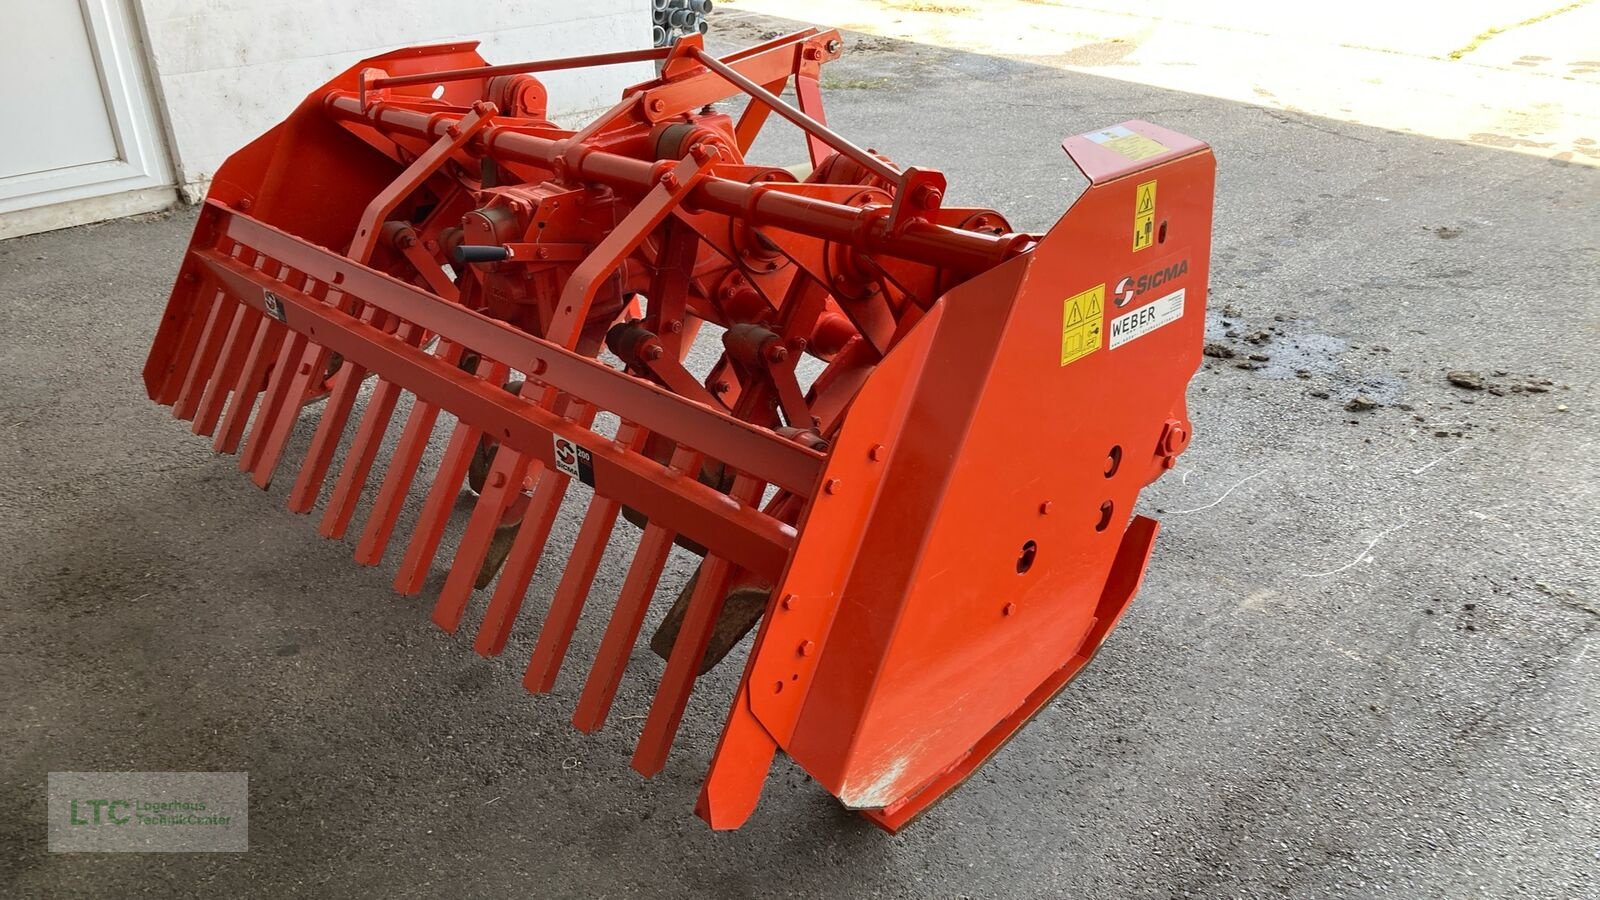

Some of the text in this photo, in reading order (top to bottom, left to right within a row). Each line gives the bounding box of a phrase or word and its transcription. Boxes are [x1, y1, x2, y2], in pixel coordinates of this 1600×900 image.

[1136, 260, 1188, 295] SICMA
[1112, 306, 1155, 337] WEBER
[556, 460, 578, 476] SICMA
